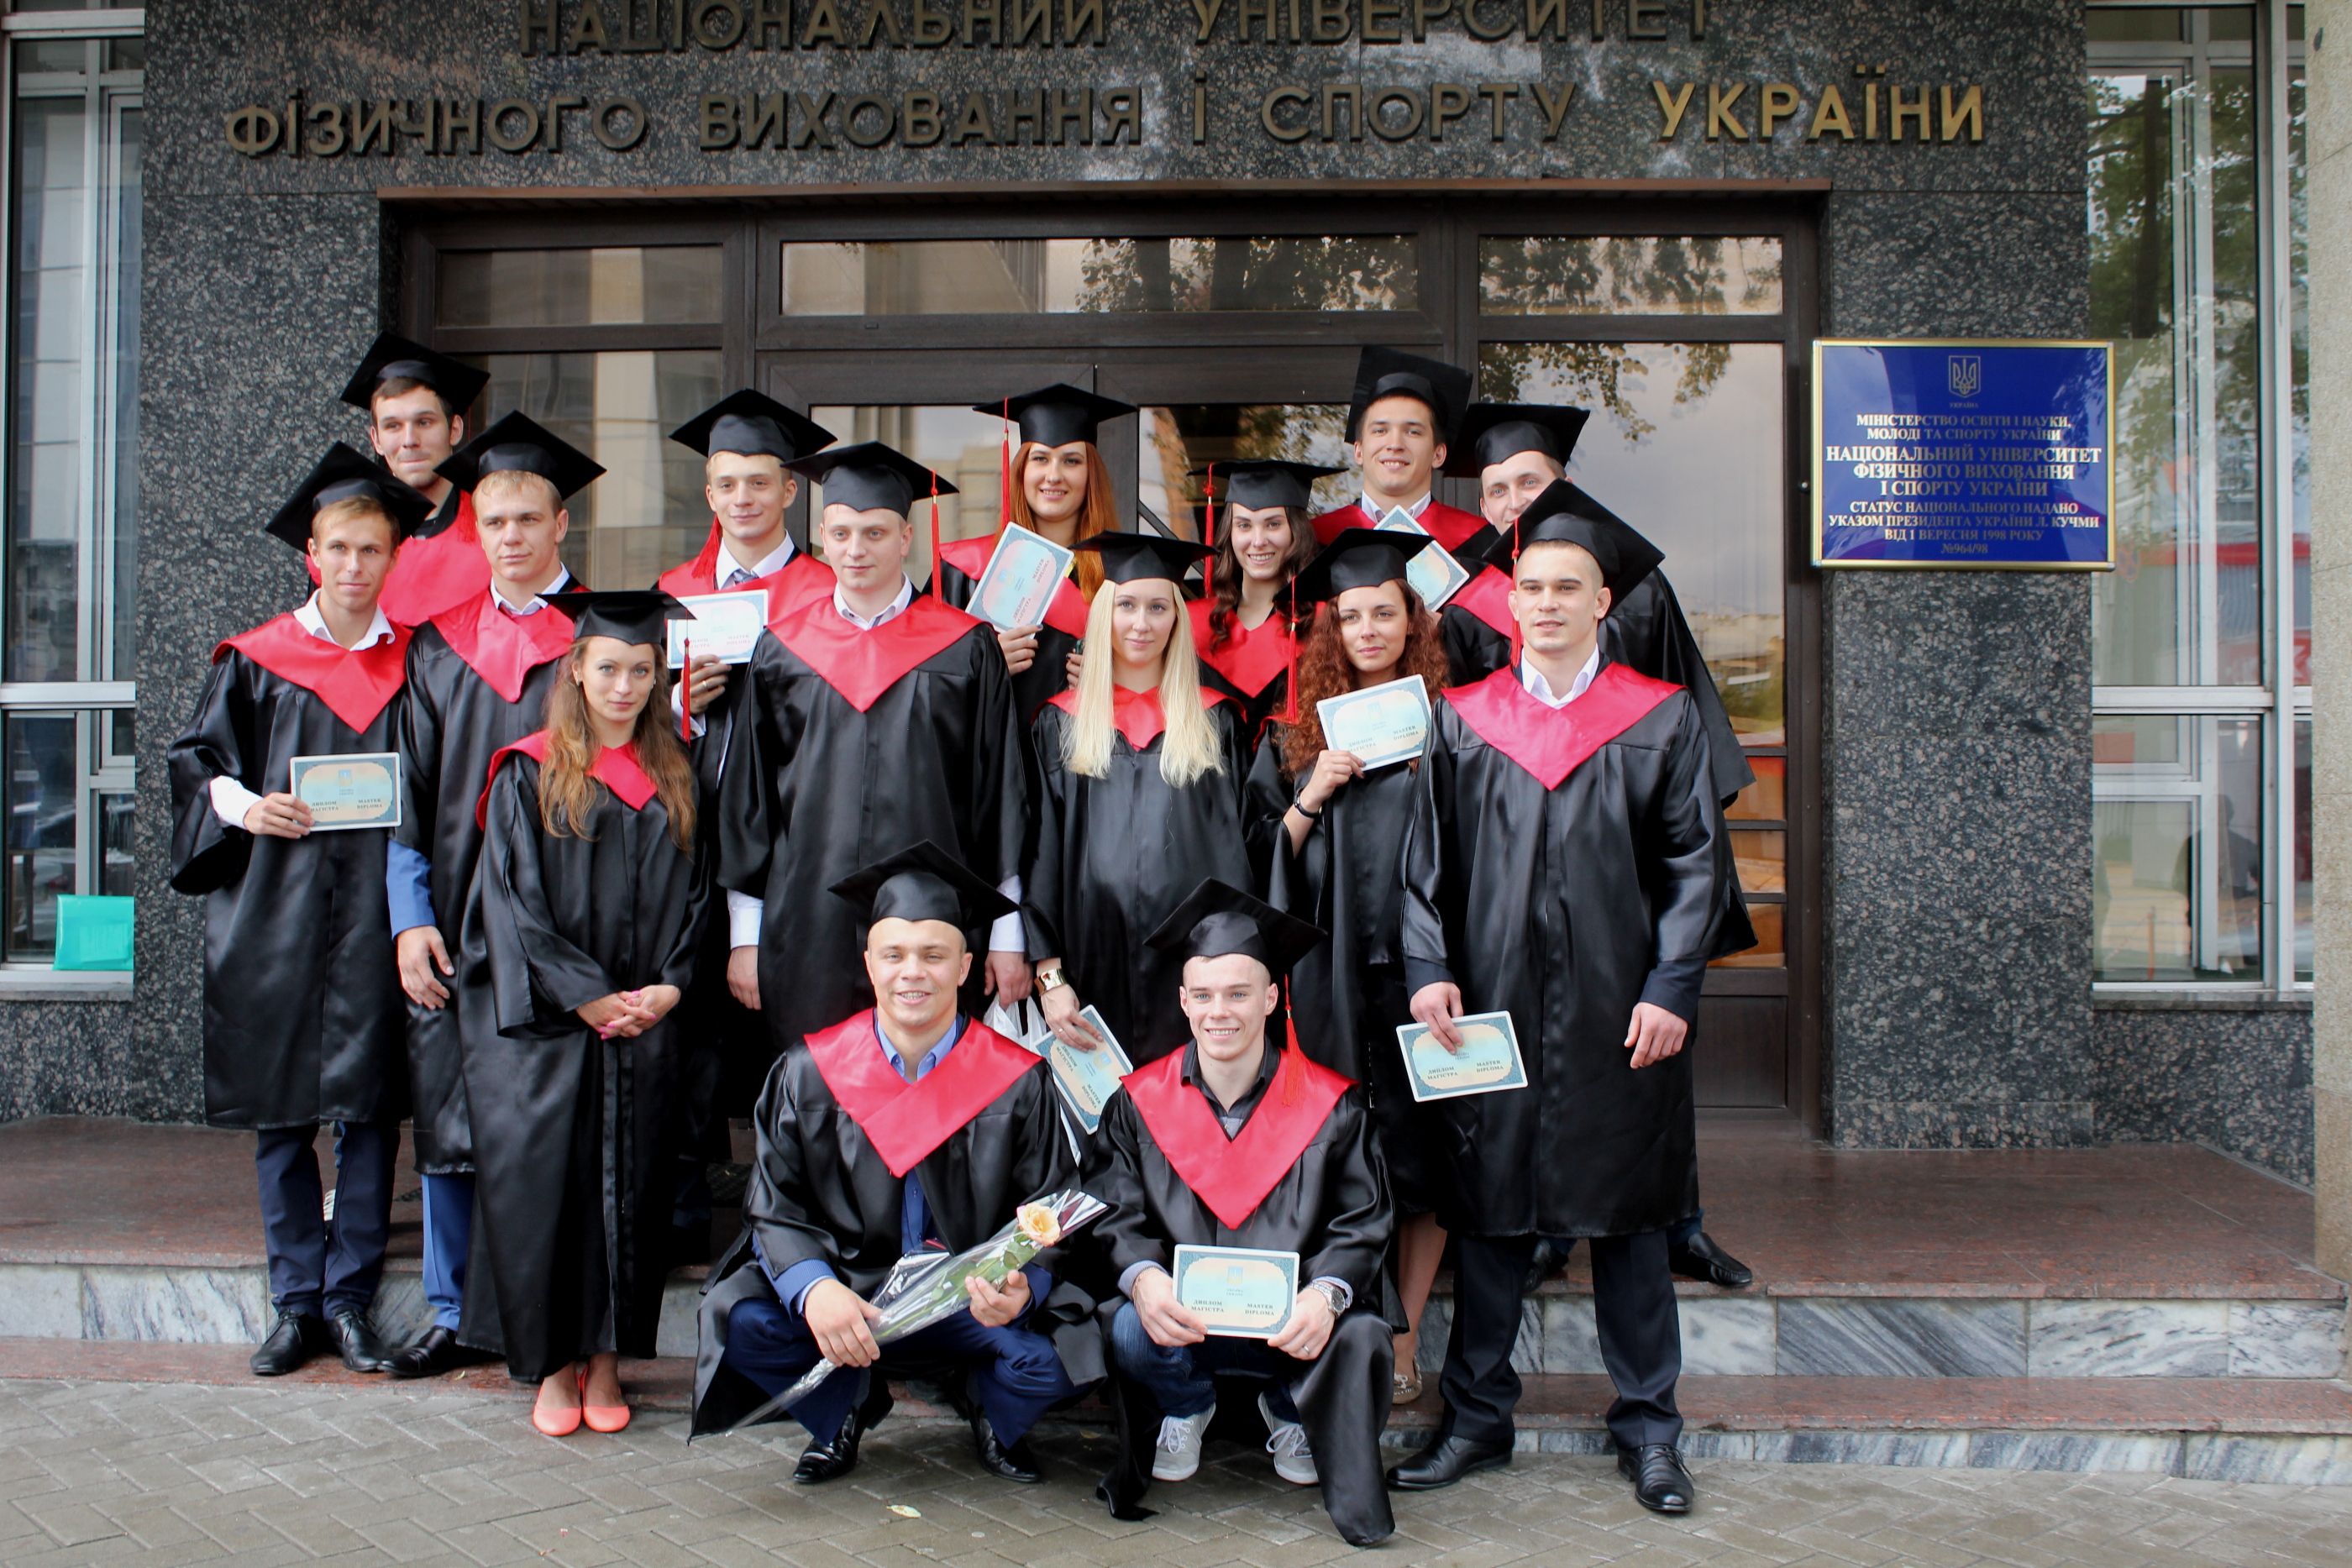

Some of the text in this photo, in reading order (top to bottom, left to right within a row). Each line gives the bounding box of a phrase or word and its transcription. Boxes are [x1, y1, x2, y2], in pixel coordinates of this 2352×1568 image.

[224, 88, 648, 158] ФІЗИЧНОГО
[699, 85, 1143, 150] ВИХОВАННЯ
[1261, 82, 1577, 144] СПОРТУ
[1650, 65, 1984, 144] УКРАЇНИ
[1856, 414, 2071, 428] МІНІСТЕРСТВО ОСВІТИ І НАУКИ,
[1866, 427, 2061, 441] МОЛОДІ ТА СПОРТУ УКРАЇНИ
[1826, 443, 2102, 463] НАЦІОНАЛЬНИЙ УНІВЕРСИТЕТ
[1853, 463, 2075, 480] ФІЗИЧНОГО ВИХОВАННЯ
[1880, 479, 2048, 496] І СПОРТУ УКРАЇНИ
[1850, 501, 2079, 515] СТАТУС НАЦІОНАЛЬНОГО НАДАНО
[1829, 514, 2099, 528] УКАЗОМ ПРЕЗИДЕНТА УКРАЇНИ Л. КУЧМИ
[1884, 529, 2045, 542] ВІД 1 ВЕРЕСНЯ 1998 РОКУ
